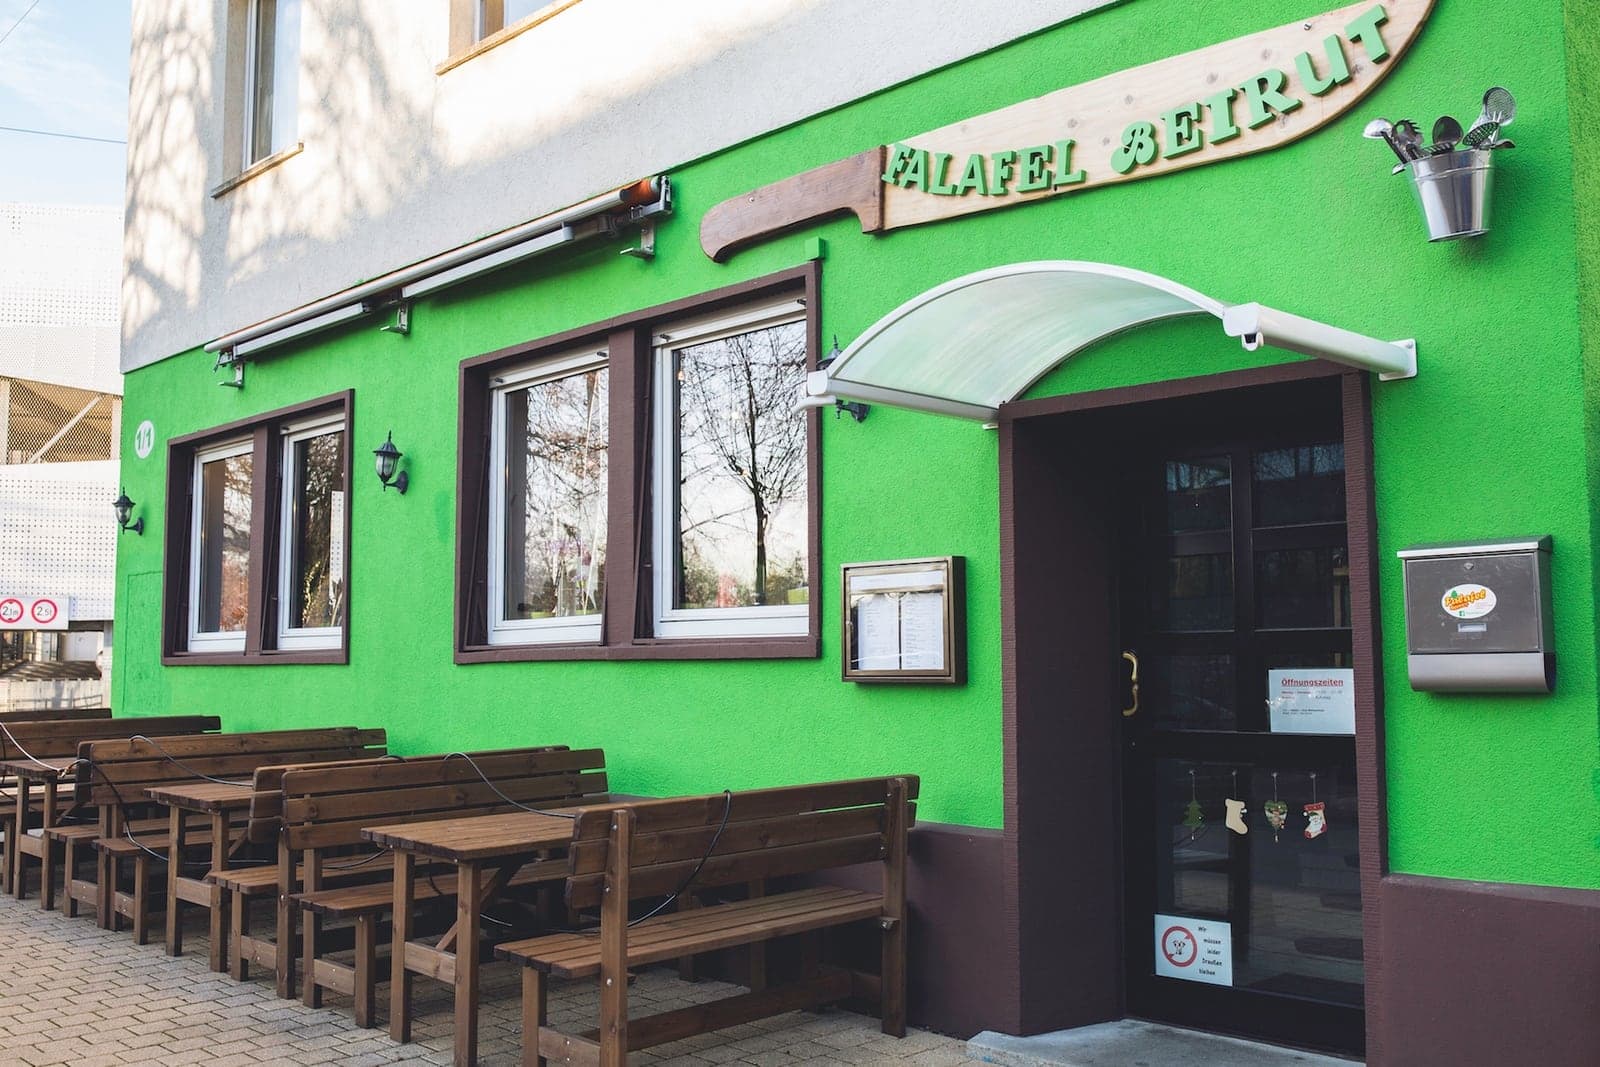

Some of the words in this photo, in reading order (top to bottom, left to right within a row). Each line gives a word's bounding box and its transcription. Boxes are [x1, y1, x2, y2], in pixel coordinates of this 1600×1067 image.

[881, 138, 1087, 196] FALAFEL
[1111, 4, 1389, 174] BEIRUT
[1281, 677, 1344, 687] Öffnungszeiten
